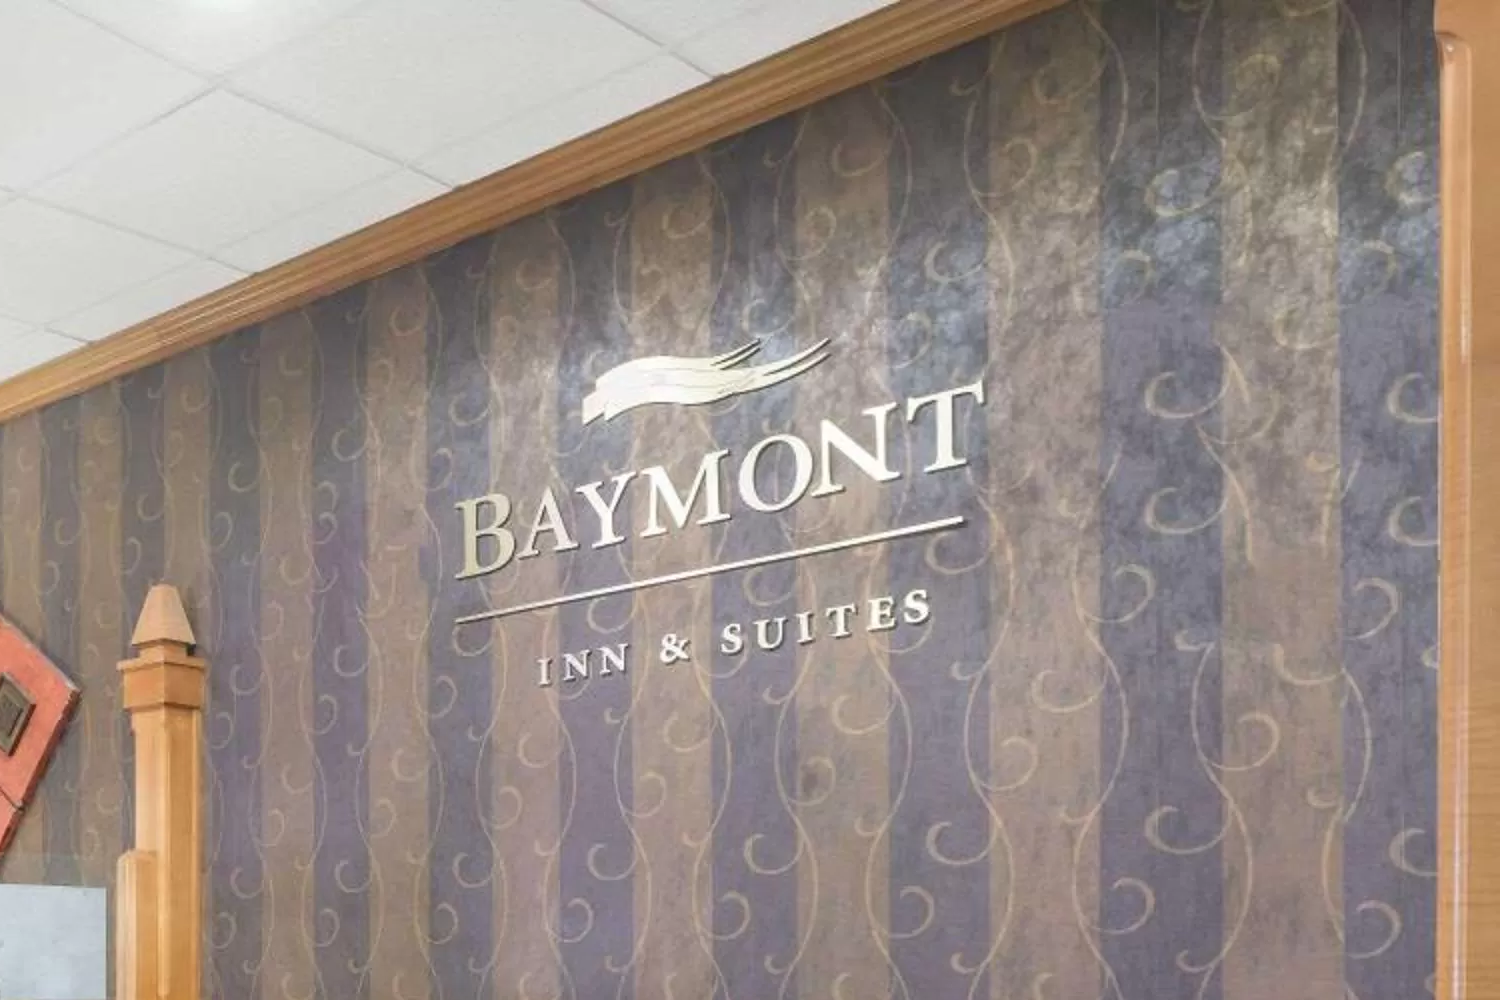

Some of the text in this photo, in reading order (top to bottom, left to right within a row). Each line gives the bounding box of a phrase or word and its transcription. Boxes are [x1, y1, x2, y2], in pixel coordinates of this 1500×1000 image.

[454, 379, 985, 580] BAYMONT
[537, 589, 930, 687] INN & SUITES
